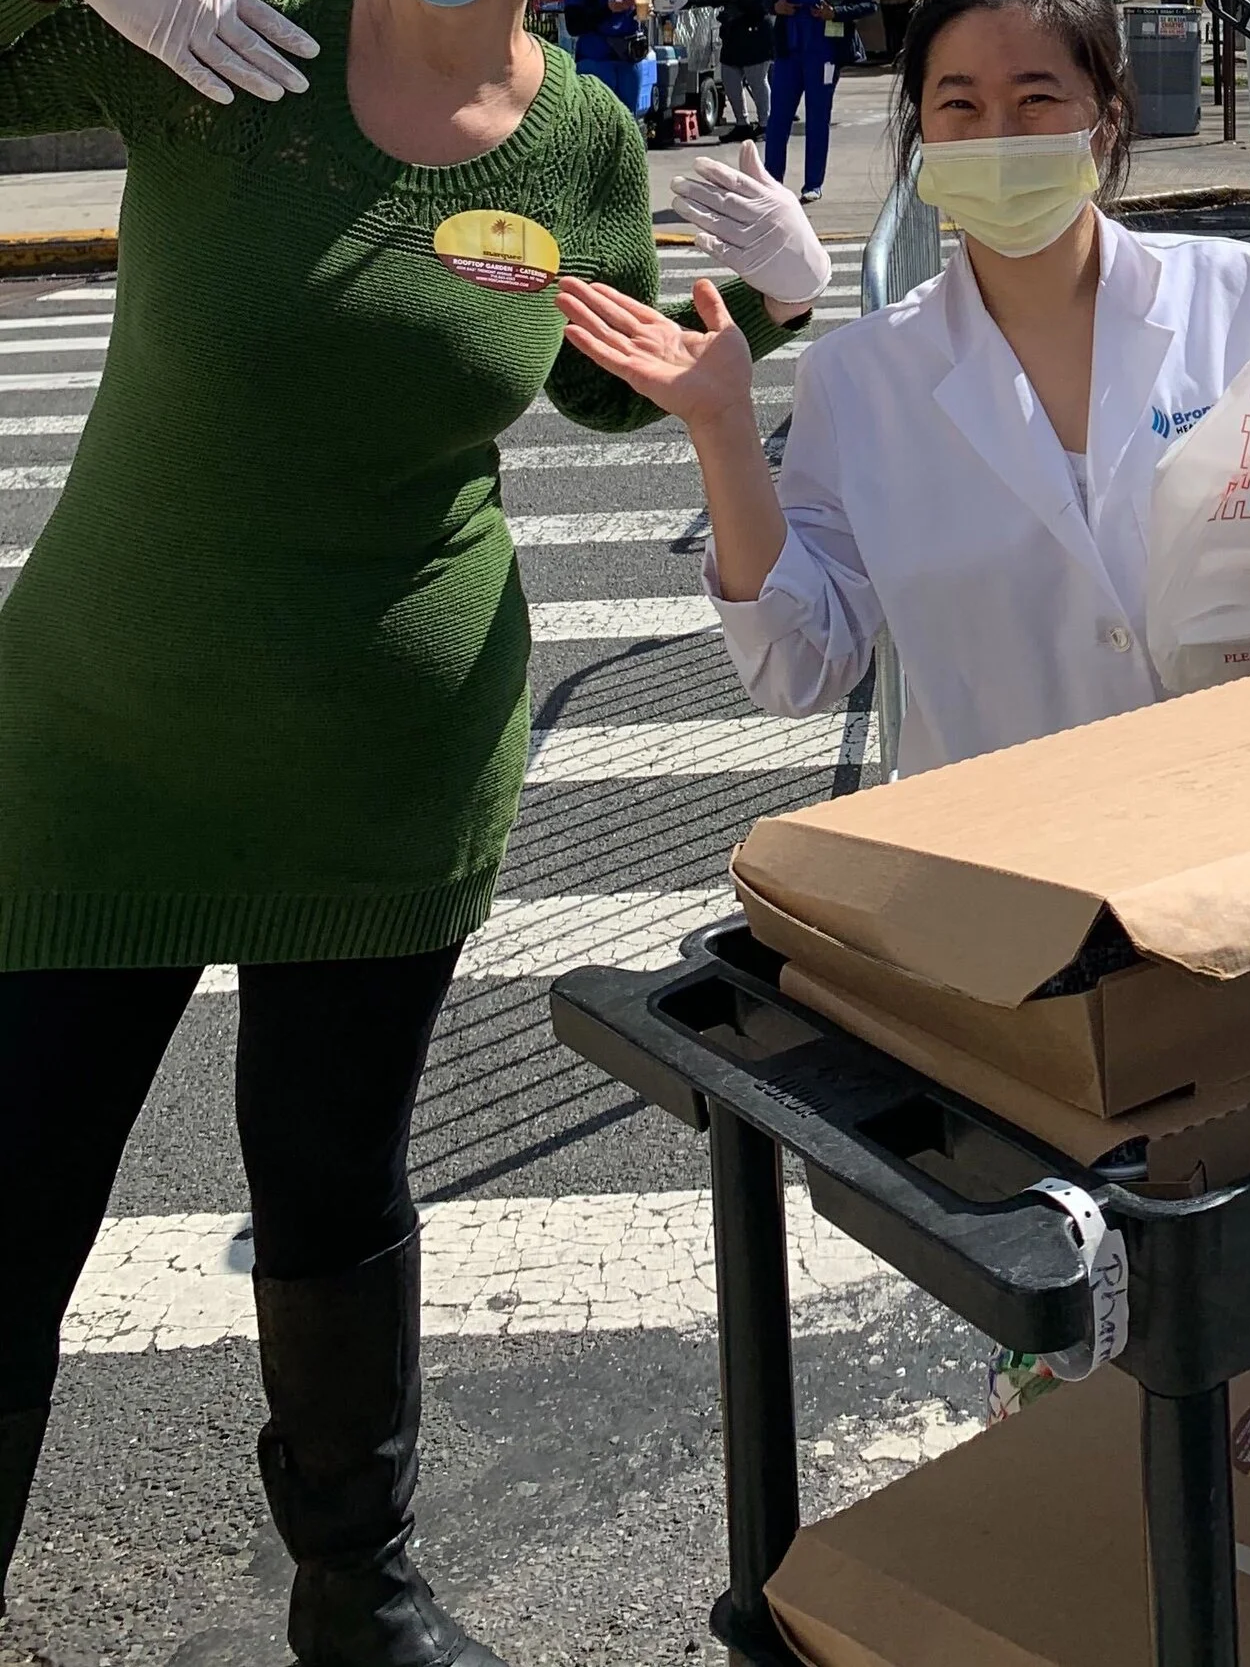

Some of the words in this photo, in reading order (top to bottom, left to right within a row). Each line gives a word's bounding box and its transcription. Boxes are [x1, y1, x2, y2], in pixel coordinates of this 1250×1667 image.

[453, 258, 485, 268] ROOFTOP
[485, 263, 513, 272] GARDEN
[520, 267, 548, 279] CATERING
